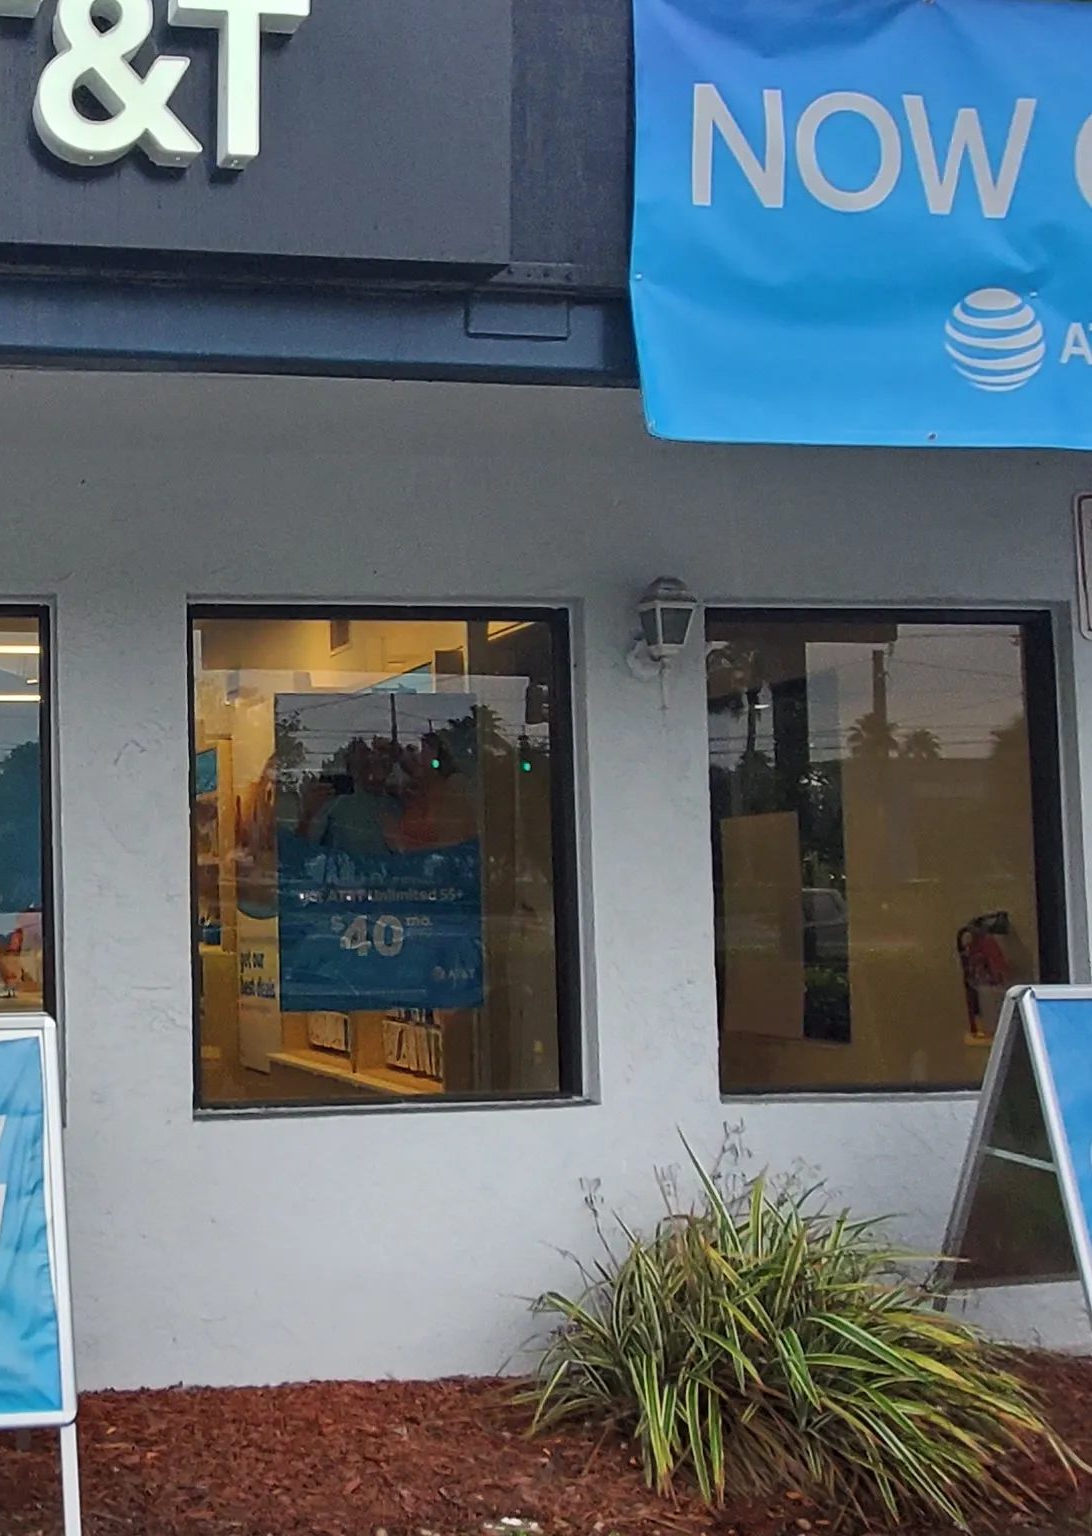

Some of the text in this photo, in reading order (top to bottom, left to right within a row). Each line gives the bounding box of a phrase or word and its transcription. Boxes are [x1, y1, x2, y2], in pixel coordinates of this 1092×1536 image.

[691, 82, 1038, 220] NOW
[1059, 321, 1092, 365] A
[369, 887, 436, 902] Unlimited
